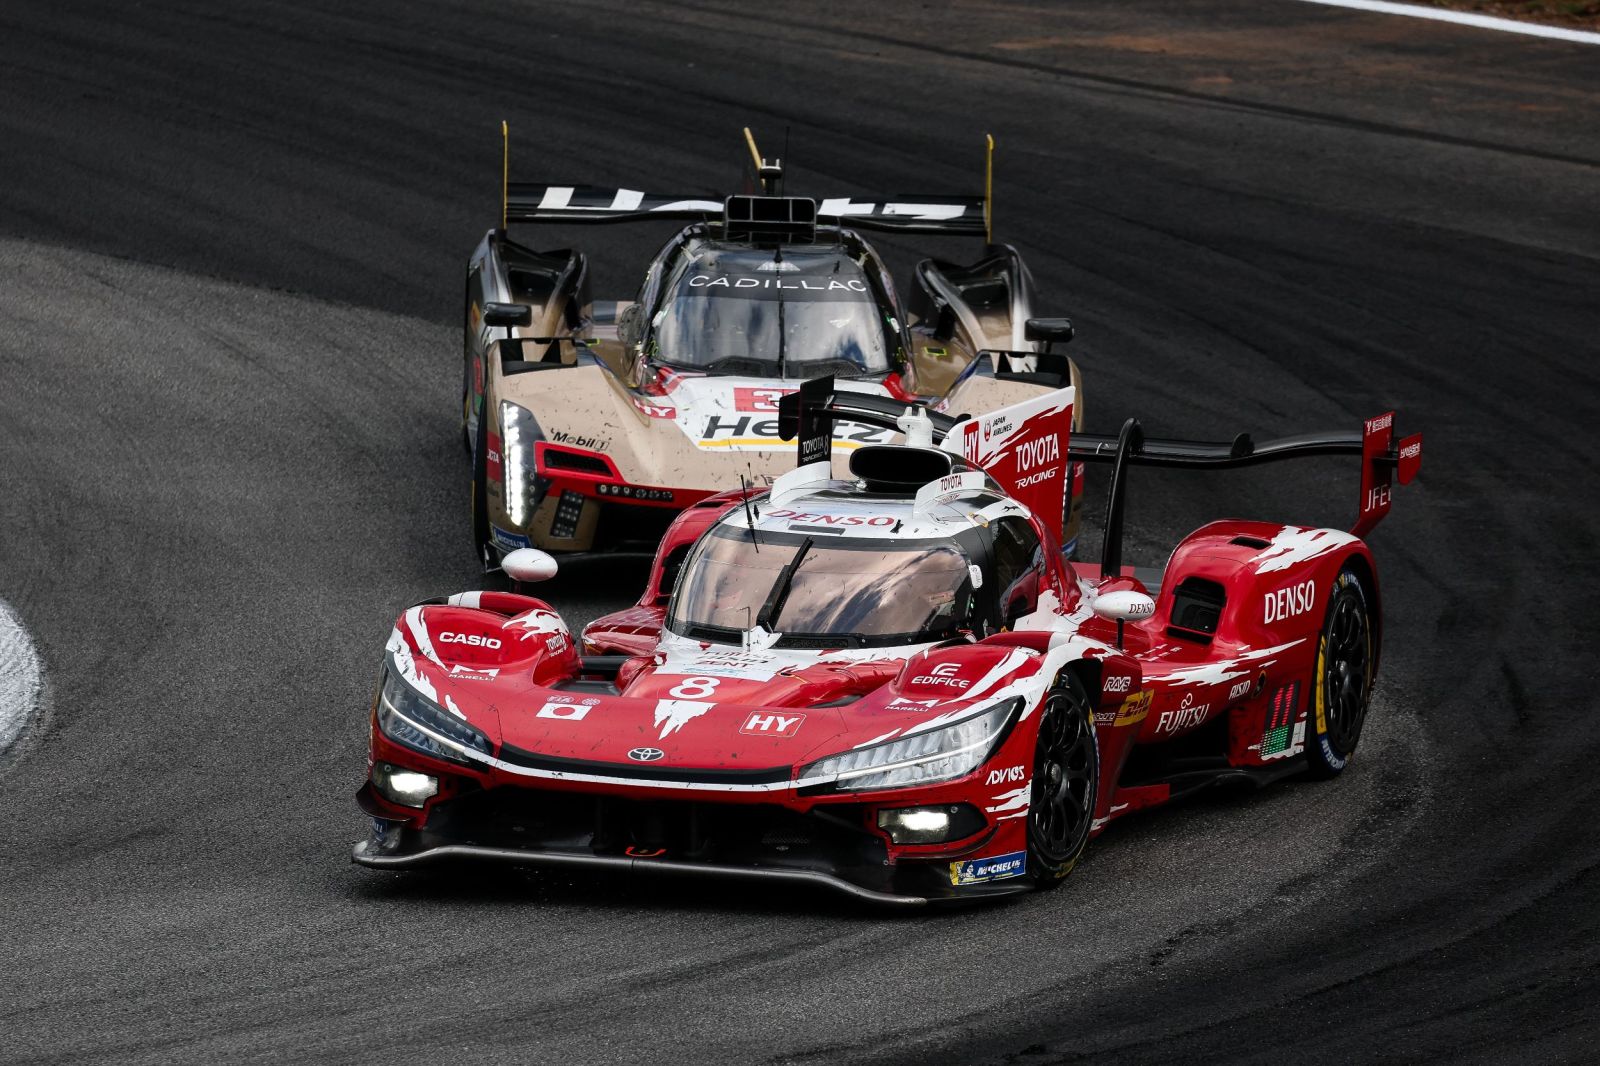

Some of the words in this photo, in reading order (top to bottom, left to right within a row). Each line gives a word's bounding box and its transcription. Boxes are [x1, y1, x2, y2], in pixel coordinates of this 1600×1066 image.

[688, 275, 867, 291] CADILLAC
[703, 415, 888, 443] Hetz
[992, 416, 1006, 427] JAPAN
[992, 423, 1013, 437] AIRLINES
[802, 436, 824, 454] TOYOTA
[964, 430, 979, 463] HY
[1015, 433, 1060, 473] TOYOTA
[940, 474, 962, 492] TOYOTA
[1015, 466, 1059, 489] RACING
[766, 509, 895, 527] DENSO
[1128, 602, 1154, 614] DENSO
[1264, 580, 1315, 624] DENSO
[439, 631, 501, 649] CASIO
[448, 673, 495, 682] MARELLI
[911, 675, 970, 688] EDIFICE
[1103, 676, 1131, 692] RAYS
[669, 676, 721, 699] 8
[745, 714, 800, 732] HY
[1155, 703, 1210, 737] FUJITSU
[976, 858, 1022, 876] MICHELIN
